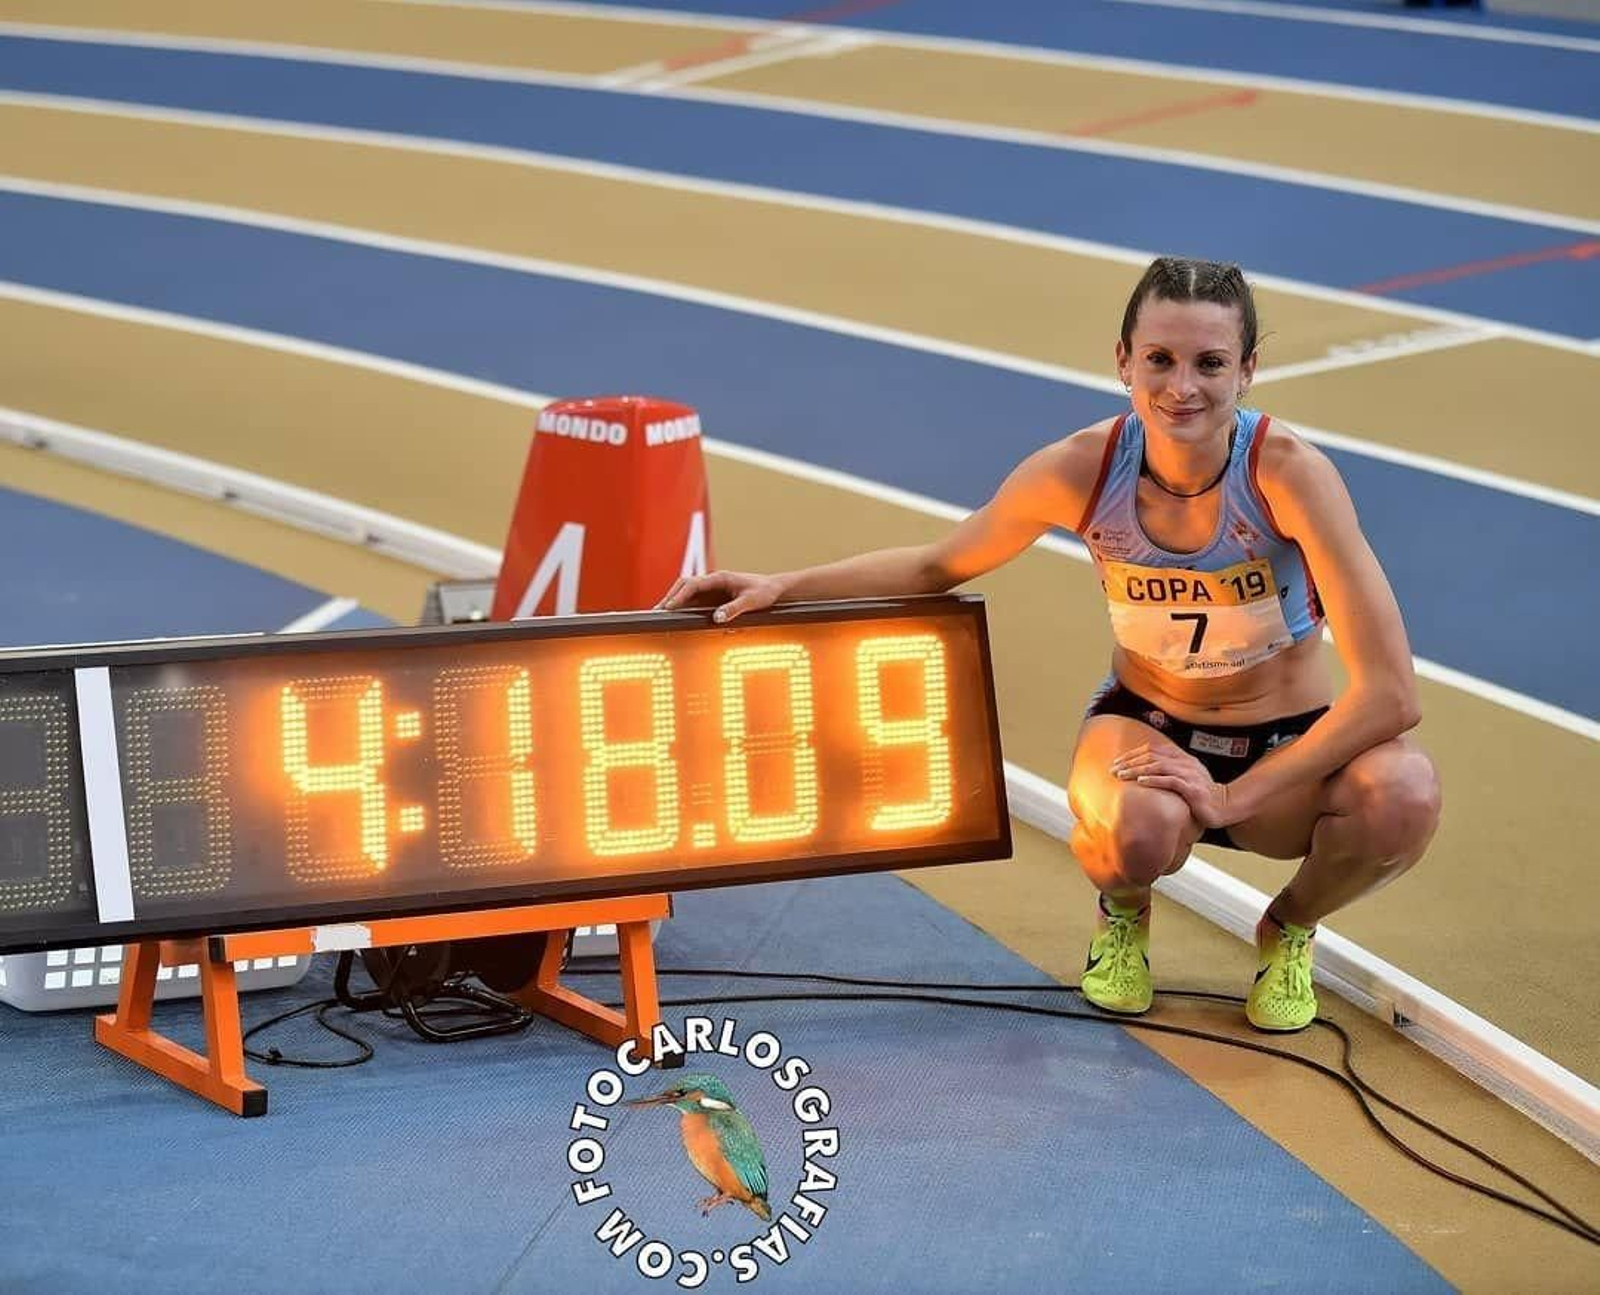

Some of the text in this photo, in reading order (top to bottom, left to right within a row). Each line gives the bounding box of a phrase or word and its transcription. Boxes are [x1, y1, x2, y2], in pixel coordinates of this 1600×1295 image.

[537, 411, 628, 446] MONDO
[1126, 575, 1213, 602] COPA
[1170, 612, 1209, 654] 7
[280, 634, 953, 870] 4:18.09
